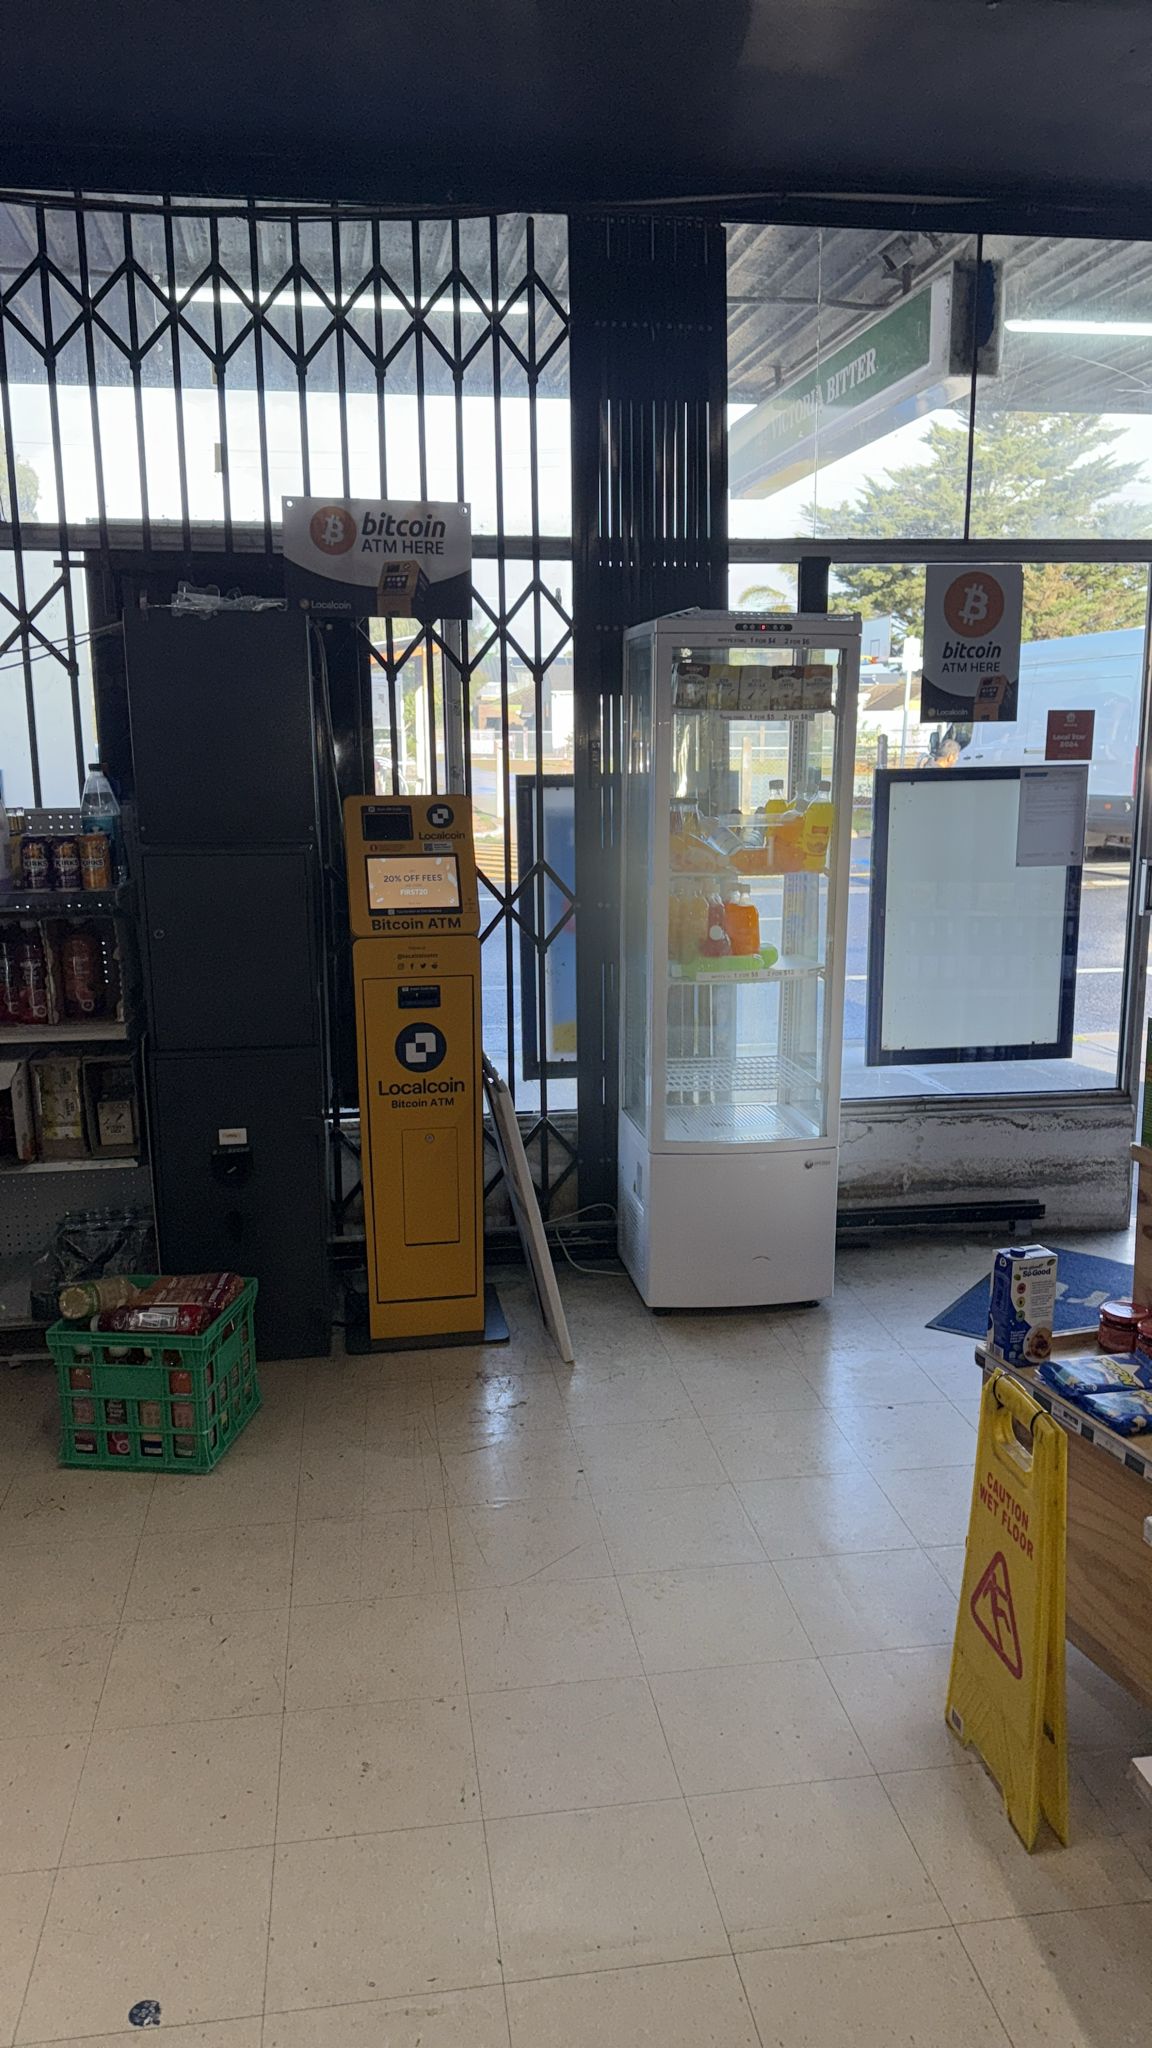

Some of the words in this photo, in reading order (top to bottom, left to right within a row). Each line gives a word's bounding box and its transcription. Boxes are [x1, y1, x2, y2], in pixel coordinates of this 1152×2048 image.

[826, 347, 877, 405] BITTER
[361, 511, 445, 538] bitcoin
[361, 539, 398, 553] ATM
[402, 540, 445, 555] HERE
[311, 599, 352, 610] Localcoin
[942, 640, 1002, 659] bitcoin
[941, 662, 968, 673] ATM
[970, 662, 1000, 673] HERE
[936, 708, 968, 717] Localcoin
[418, 830, 466, 841] Localcoin
[383, 874, 402, 883] 20%
[403, 873, 421, 882] OFF
[422, 873, 443, 882] FEES
[371, 918, 424, 931] Bitcoin
[427, 917, 462, 929] ATM
[378, 1076, 465, 1097] Localcoin
[391, 1097, 428, 1109] Bitcoin
[430, 1096, 455, 1107] ATM
[986, 1470, 1030, 1531] CAUTION
[978, 1481, 1001, 1520] WET
[1000, 1509, 1036, 1562] FLOOR
